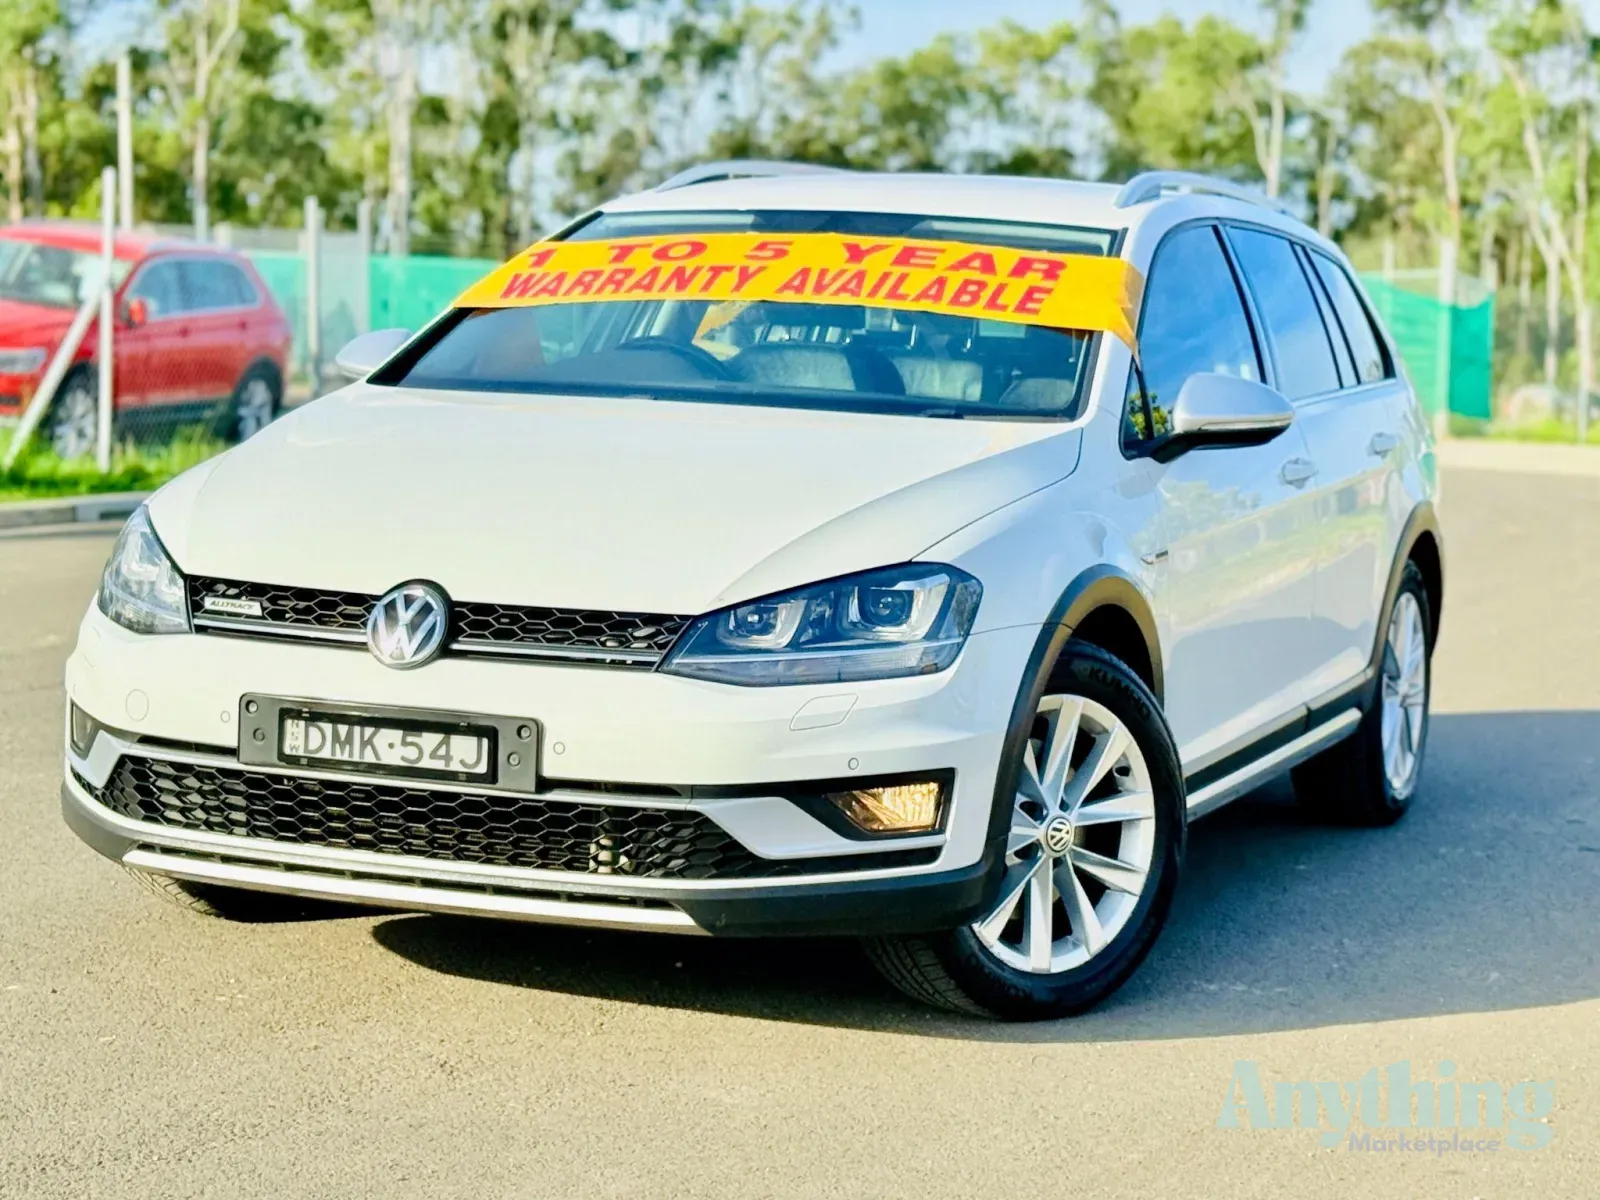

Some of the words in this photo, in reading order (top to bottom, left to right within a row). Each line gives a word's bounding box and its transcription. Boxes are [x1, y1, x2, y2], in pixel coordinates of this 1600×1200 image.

[527, 248, 558, 269] 1
[607, 241, 708, 264] TO
[743, 240, 795, 261] 5
[841, 242, 1067, 281] YEAR
[500, 265, 769, 300] WARRANTY
[773, 267, 1054, 316] AVAILABLE
